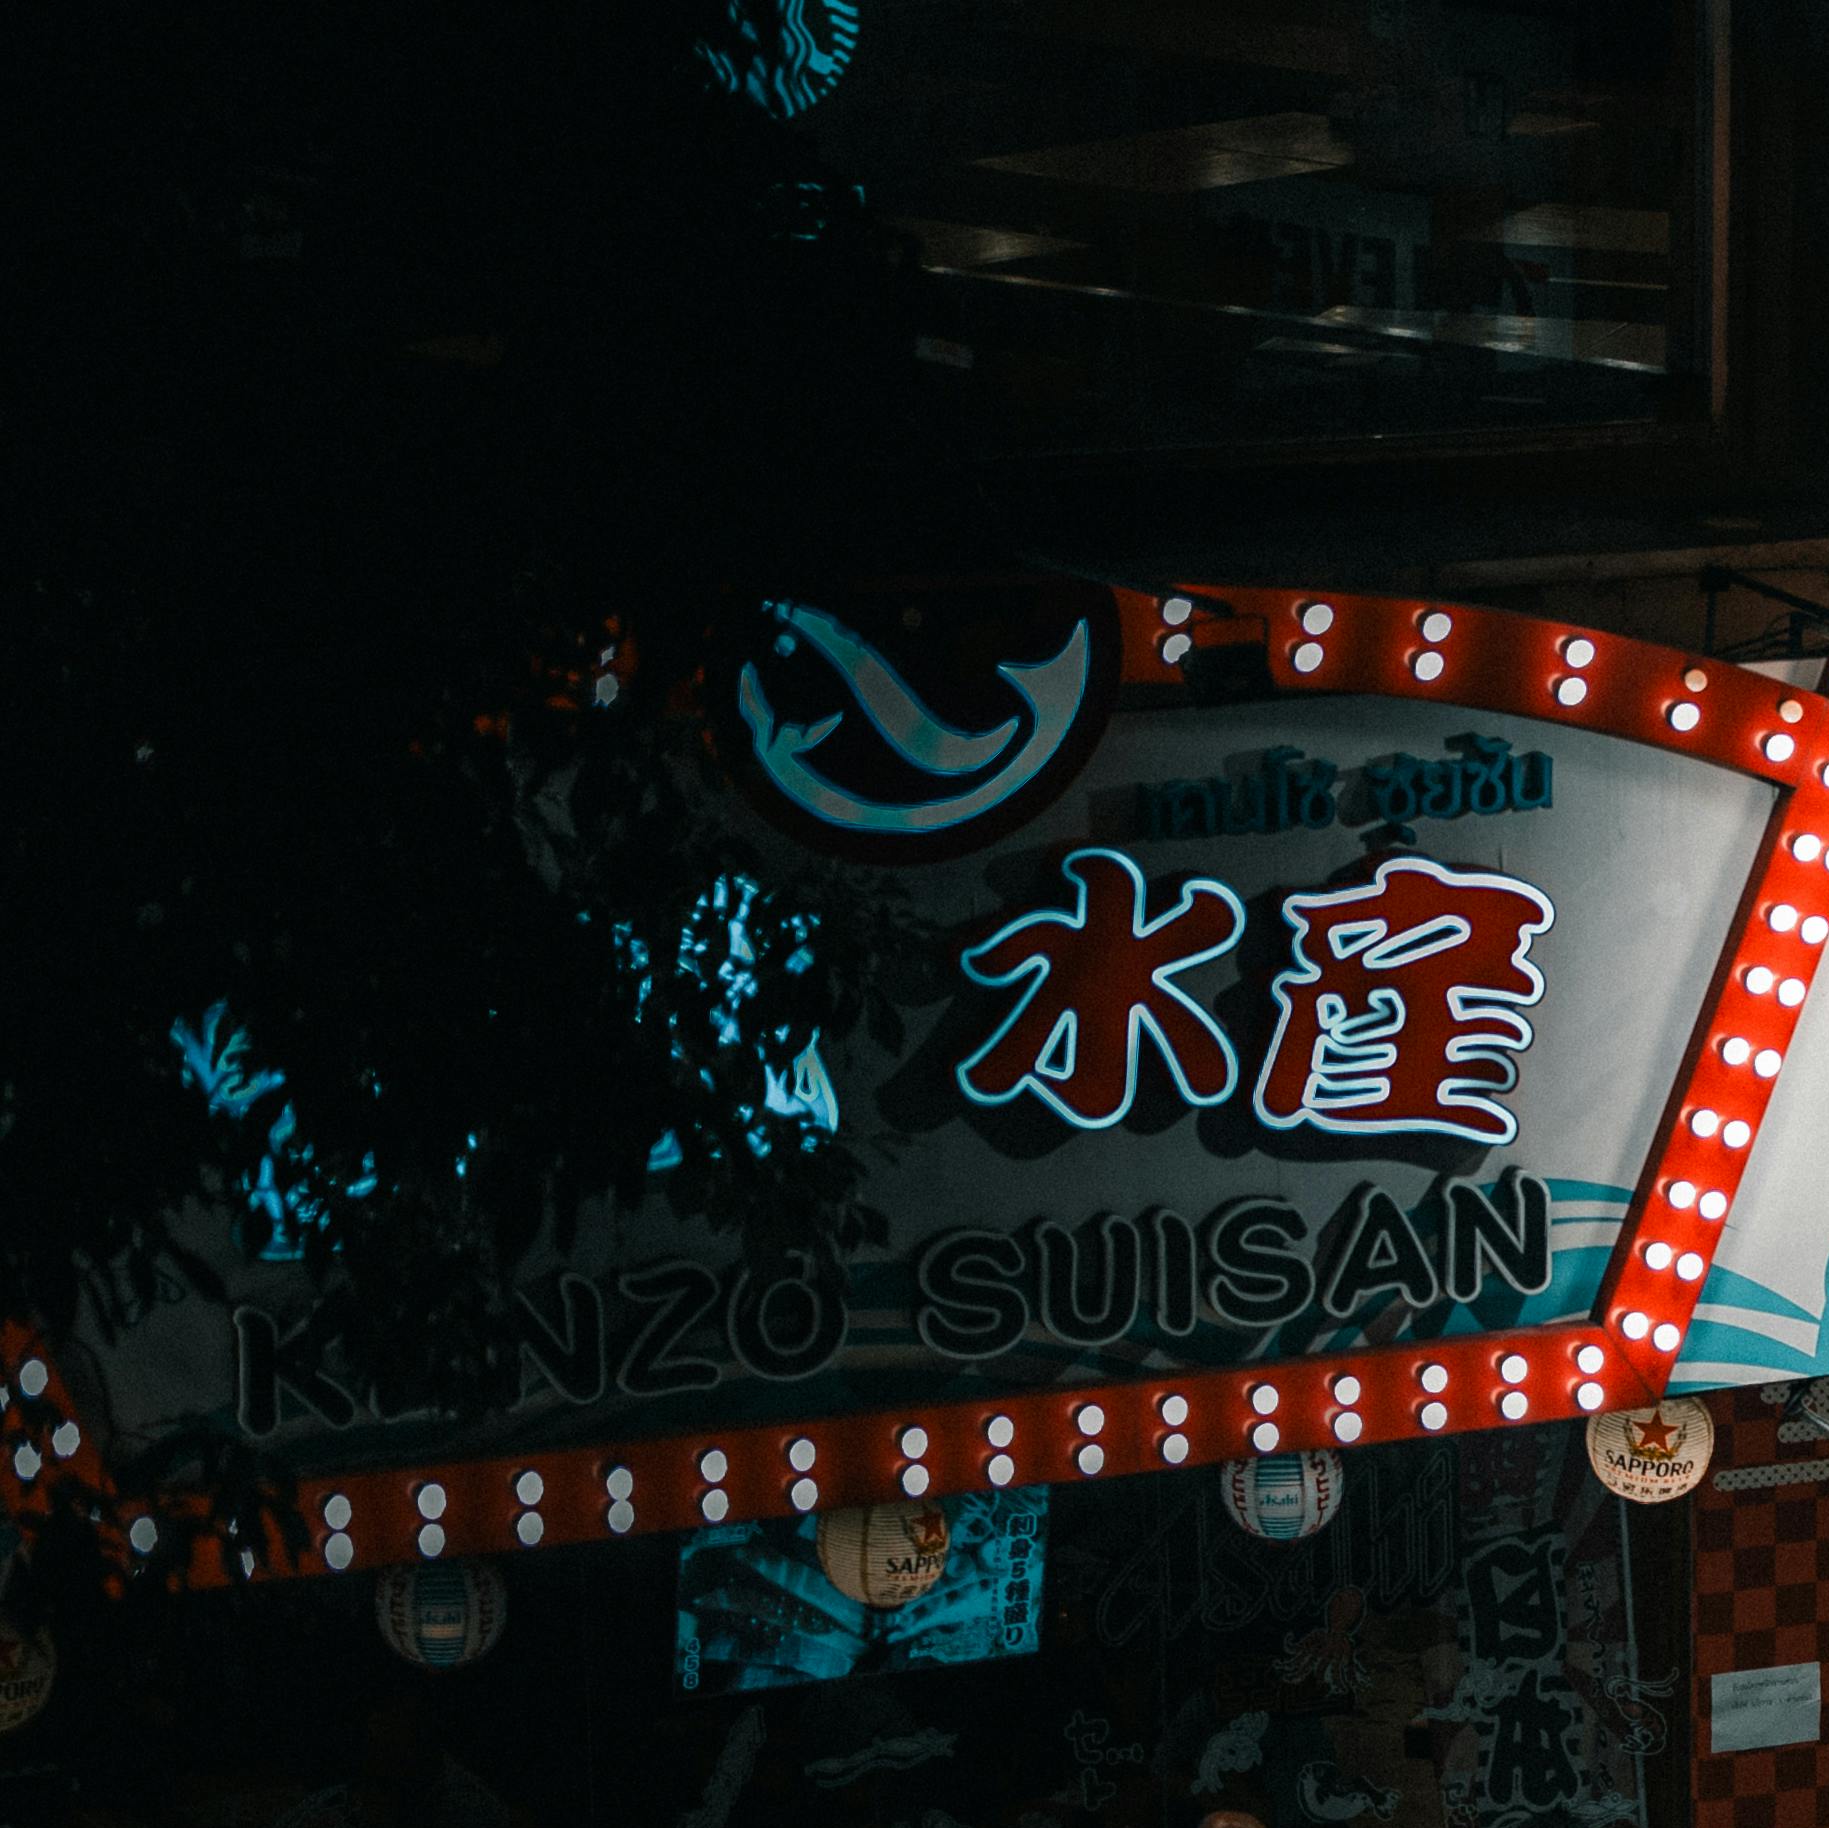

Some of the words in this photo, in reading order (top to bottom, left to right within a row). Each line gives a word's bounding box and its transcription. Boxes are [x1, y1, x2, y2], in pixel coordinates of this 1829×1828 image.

[1362, 733, 1554, 854] ซุยซัน
[956, 846, 1556, 1146] 水産
[232, 1250, 848, 1439] KNZO
[917, 1168, 1551, 1362] SUISAN
[1604, 1449, 1695, 1478] SAPPORO
